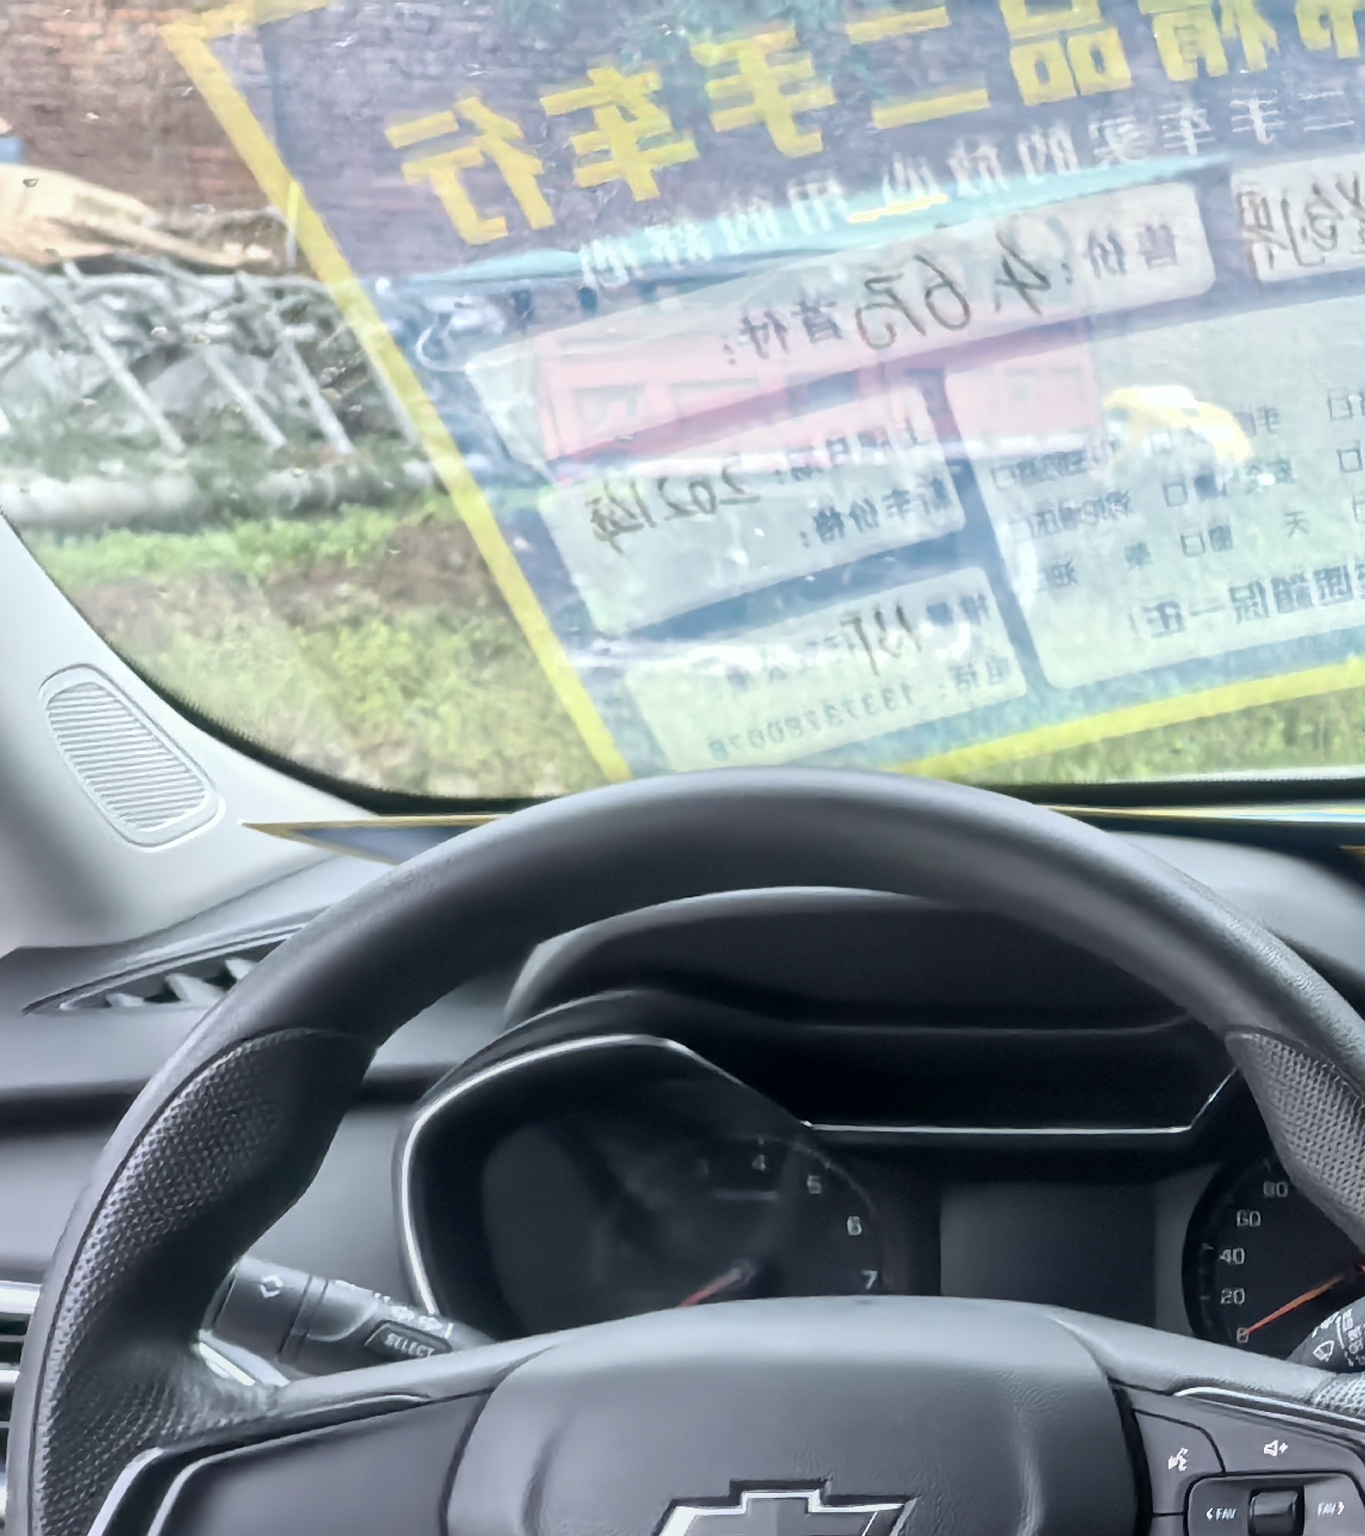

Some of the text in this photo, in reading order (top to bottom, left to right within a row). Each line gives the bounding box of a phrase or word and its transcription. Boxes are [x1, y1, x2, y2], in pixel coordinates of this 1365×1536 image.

[1219, 1247, 1246, 1264] 40
[861, 1269, 879, 1290] 7
[1220, 1287, 1246, 1305] 20
